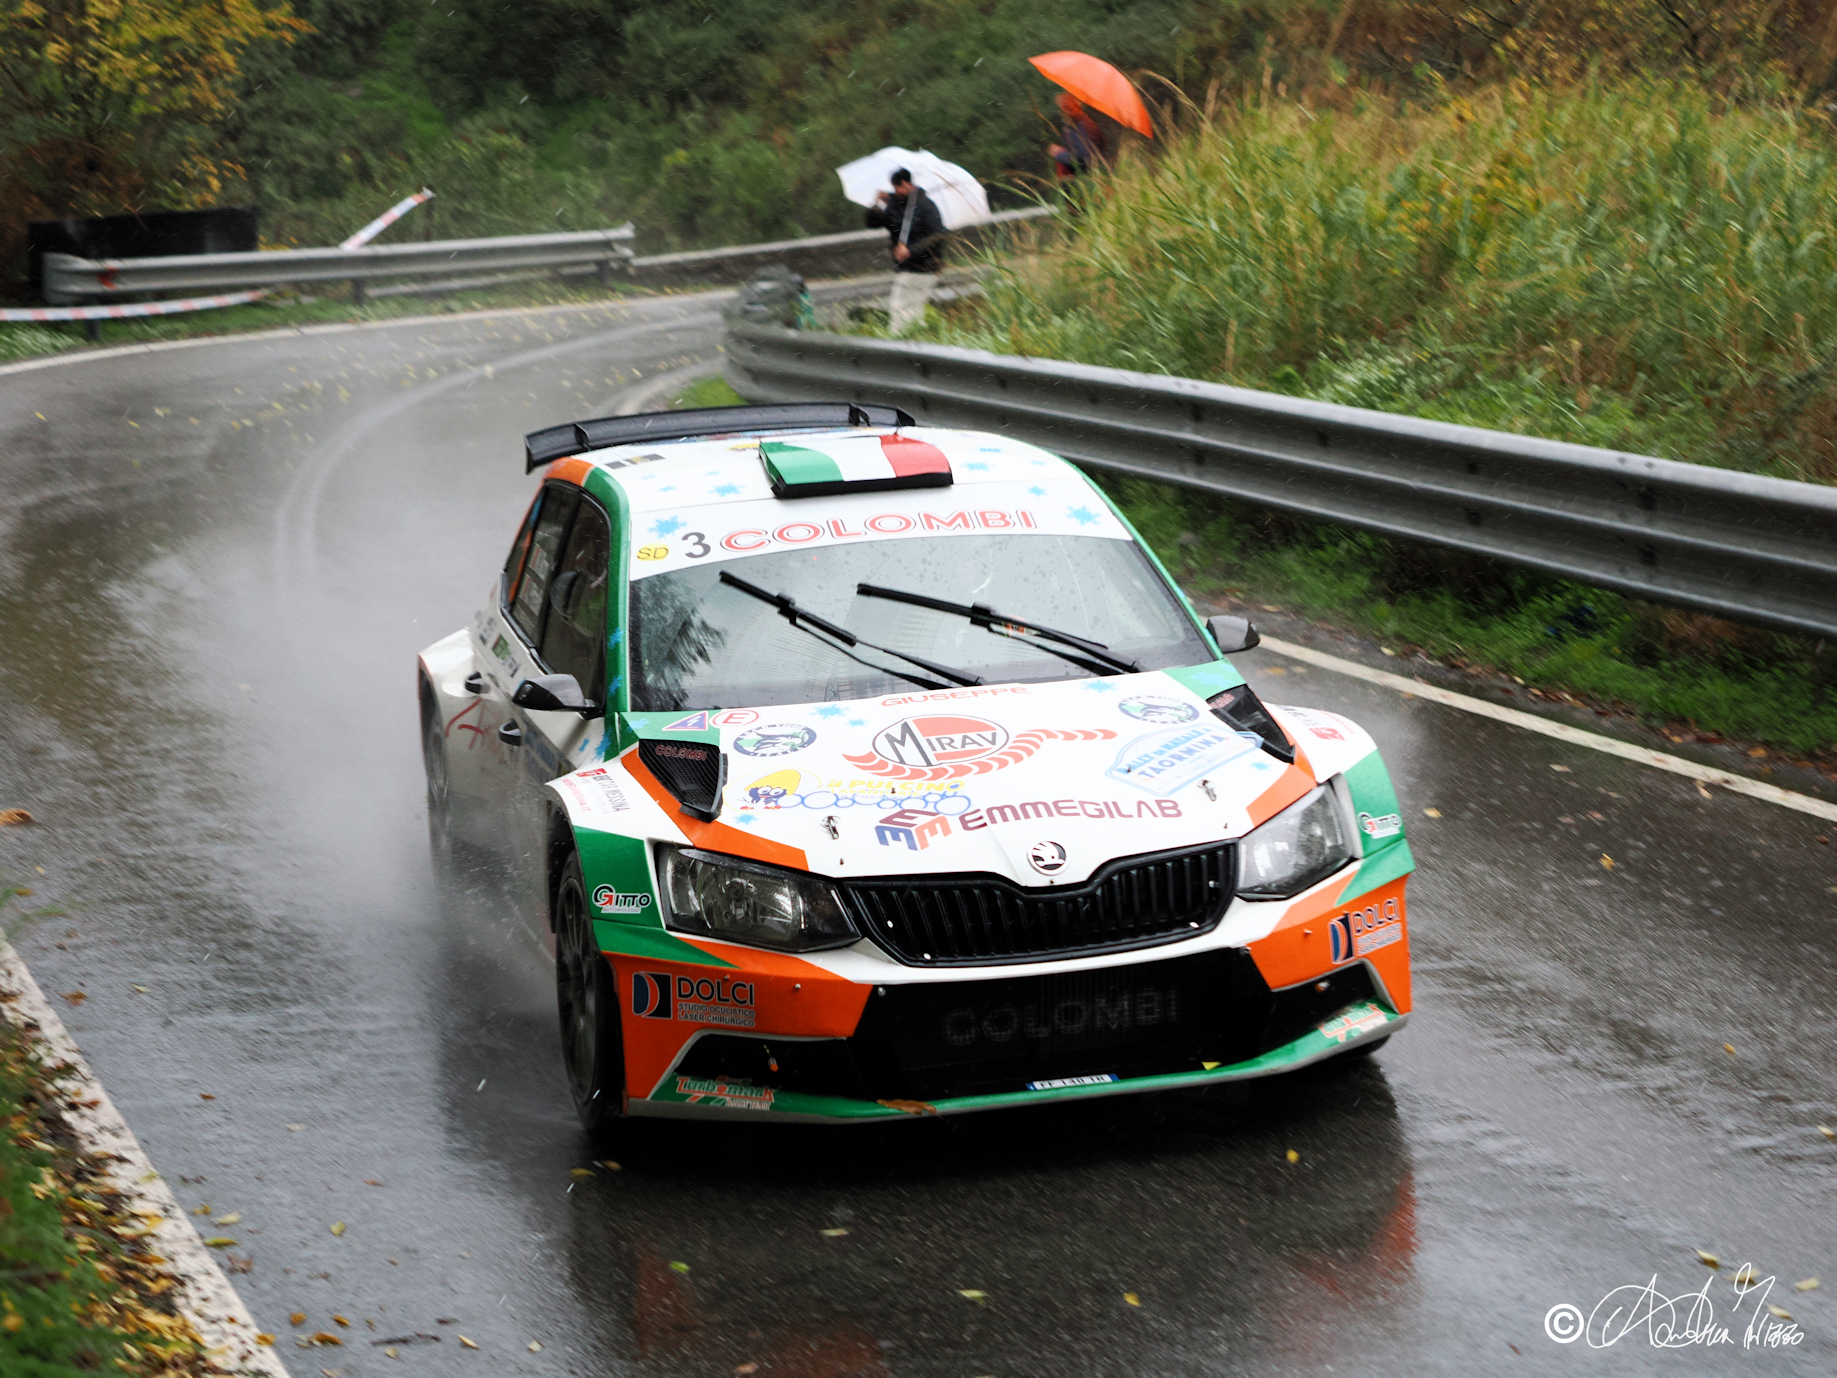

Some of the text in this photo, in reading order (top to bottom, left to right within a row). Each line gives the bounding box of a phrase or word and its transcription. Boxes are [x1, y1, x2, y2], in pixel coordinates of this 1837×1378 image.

[637, 510, 1037, 560] SD 3 COLOMBI
[881, 687, 1032, 706] GIUSEPPE
[655, 745, 707, 761] COLOMBI
[884, 721, 998, 767] MIRAV
[1137, 734, 1228, 778] TAORMINA
[849, 780, 965, 792] PULCINO
[958, 799, 1183, 831] EMMEGILAB
[593, 885, 651, 906] GITTO
[1352, 897, 1401, 935] DOLCI
[676, 976, 755, 1006] DOLCI
[678, 1002, 755, 1018] STUDIO OCULISTICO
[678, 1012, 755, 1027] LASER CHIRURGICO
[943, 985, 1180, 1045] COLOMBI
